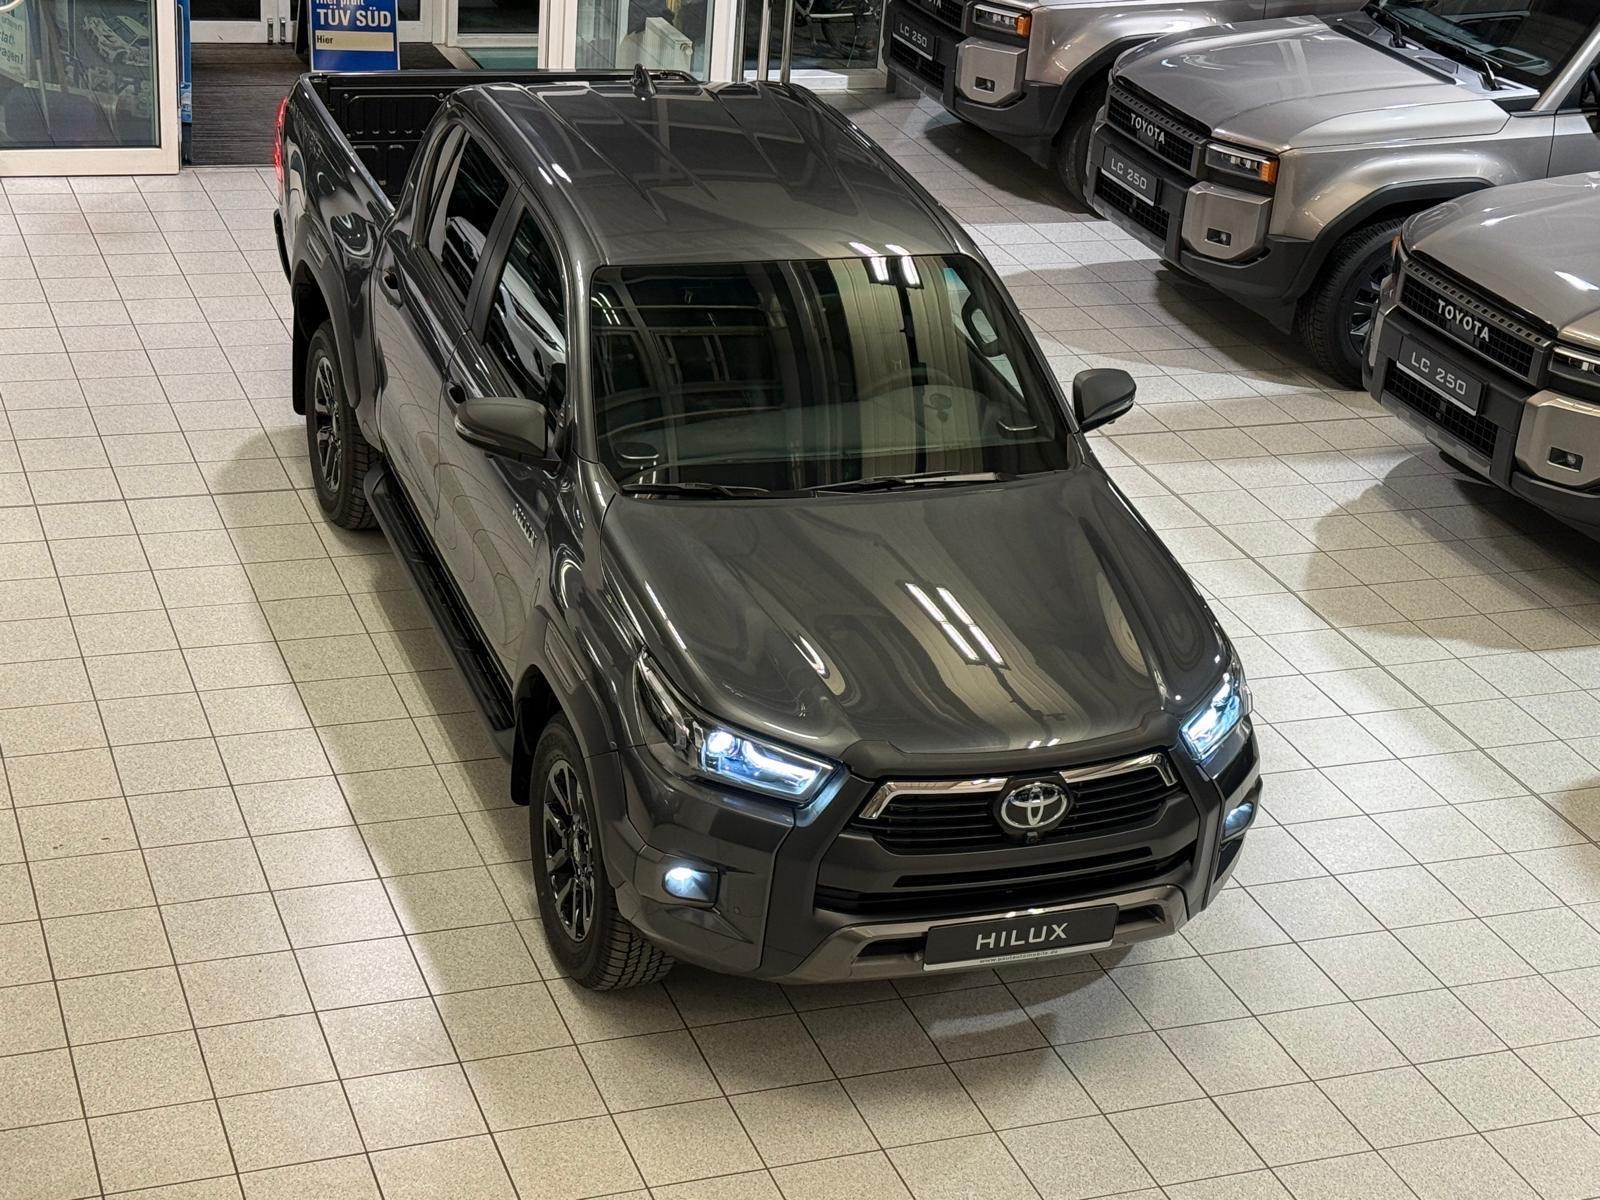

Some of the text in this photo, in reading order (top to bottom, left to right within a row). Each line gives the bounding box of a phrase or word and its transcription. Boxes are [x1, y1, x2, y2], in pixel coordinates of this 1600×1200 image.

[316, 5, 391, 28] TÜV SÜD
[316, 34, 334, 45] Hier
[899, 23, 928, 48] LC 250
[1130, 112, 1165, 145] TOYOTA
[1110, 157, 1147, 190] LC 250
[1437, 298, 1490, 342] TOYOTA
[1410, 351, 1467, 395] LC 250
[975, 922, 1068, 951] HILUX
